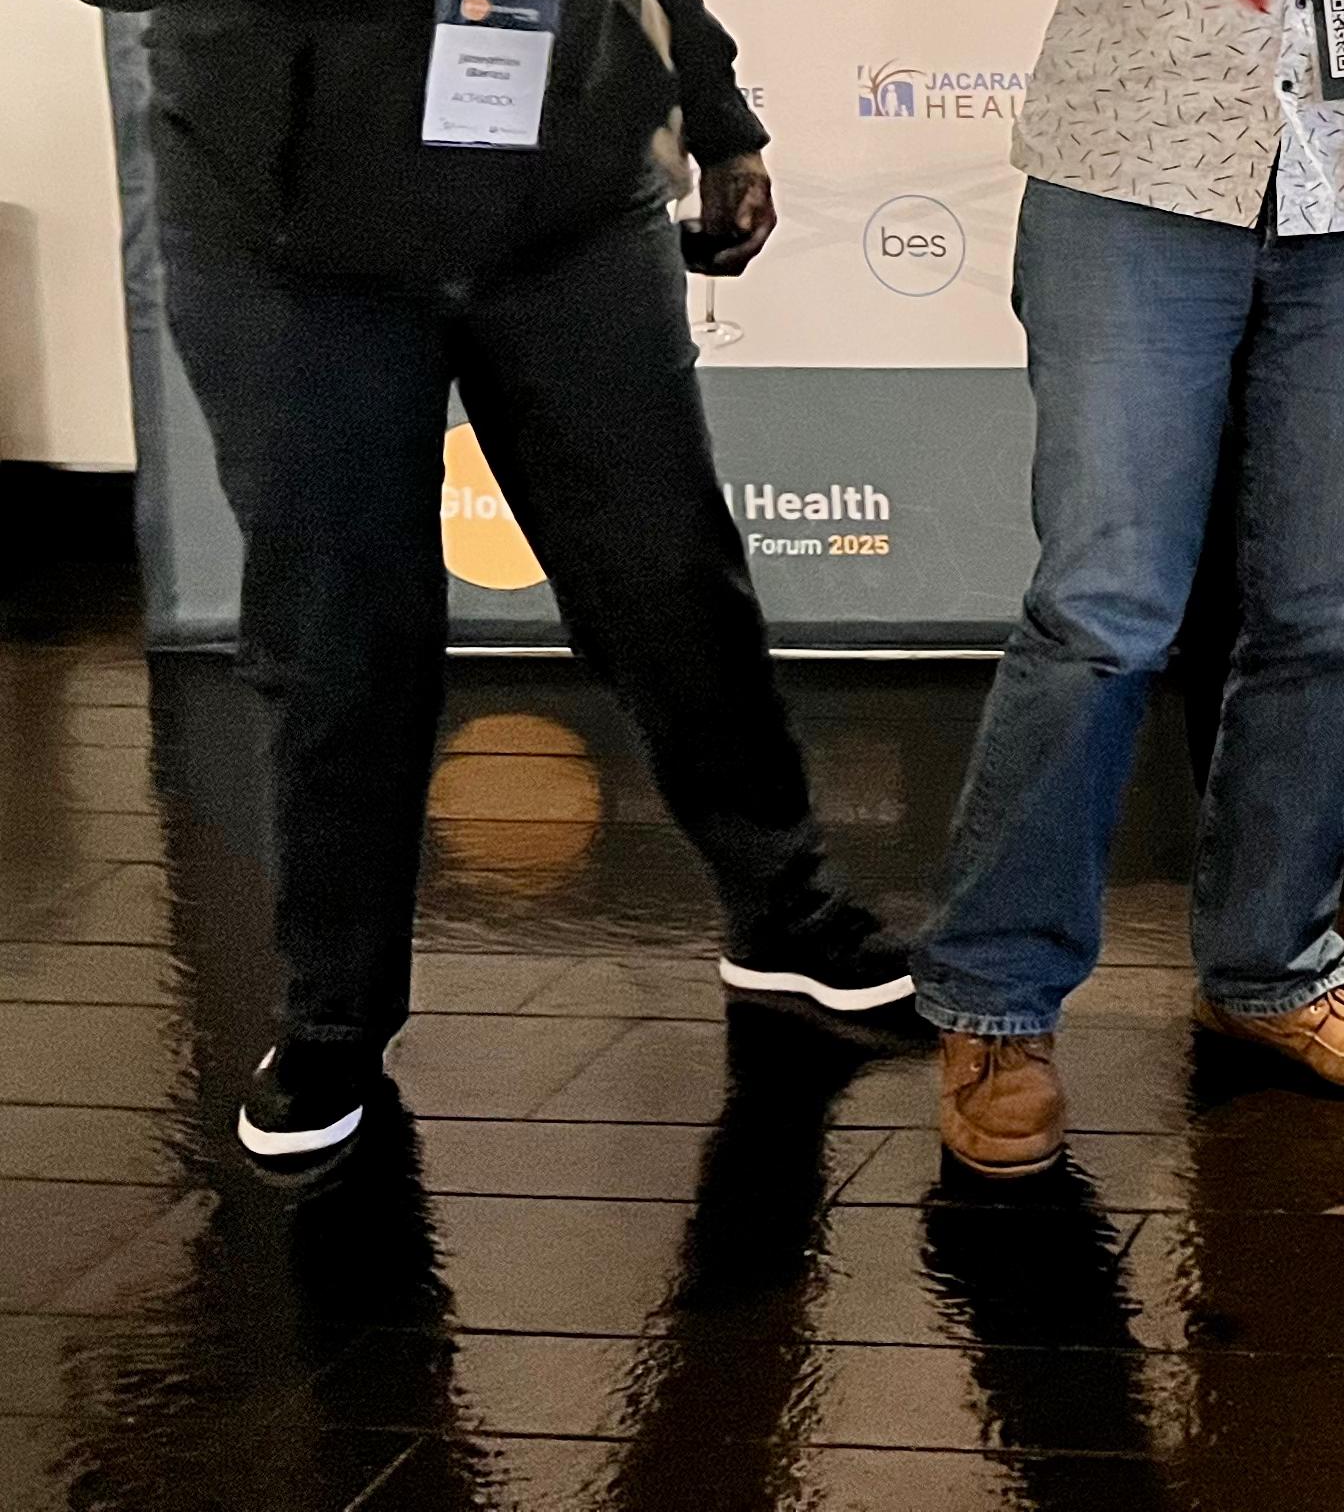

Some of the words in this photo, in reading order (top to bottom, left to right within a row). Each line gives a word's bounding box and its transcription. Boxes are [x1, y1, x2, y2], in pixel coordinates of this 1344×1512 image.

[925, 72, 1030, 90] JACARA
[881, 226, 946, 258] bes
[745, 484, 889, 521] Health
[749, 534, 822, 555] Forum
[828, 535, 888, 555] 2025
